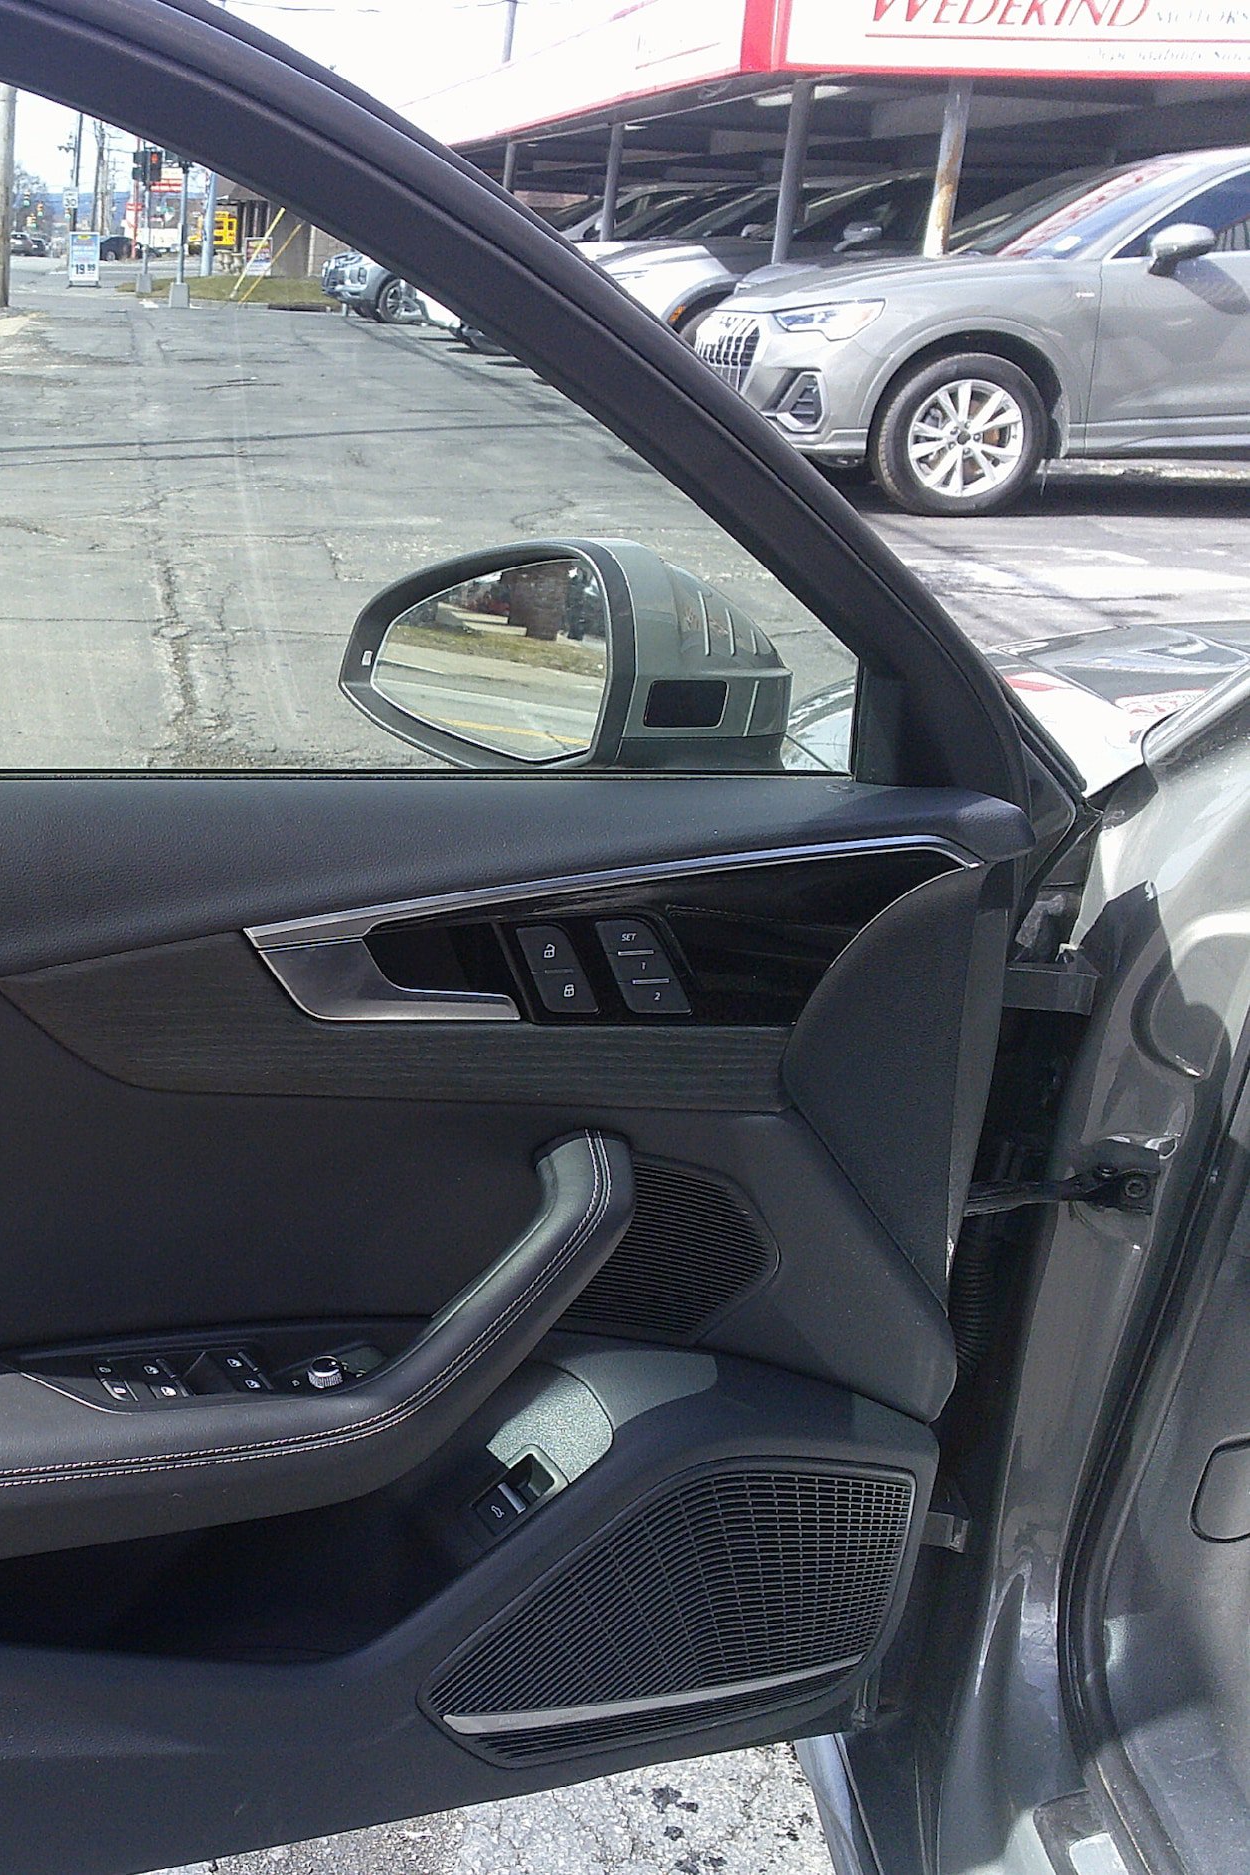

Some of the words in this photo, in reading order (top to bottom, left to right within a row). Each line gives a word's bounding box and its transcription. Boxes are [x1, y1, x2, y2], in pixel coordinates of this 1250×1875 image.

[870, 0, 1151, 27] WEDEKIND
[65, 198, 77, 208] 30
[621, 933, 637, 942] SET
[641, 961, 647, 970] 1
[654, 992, 661, 1001] 2
